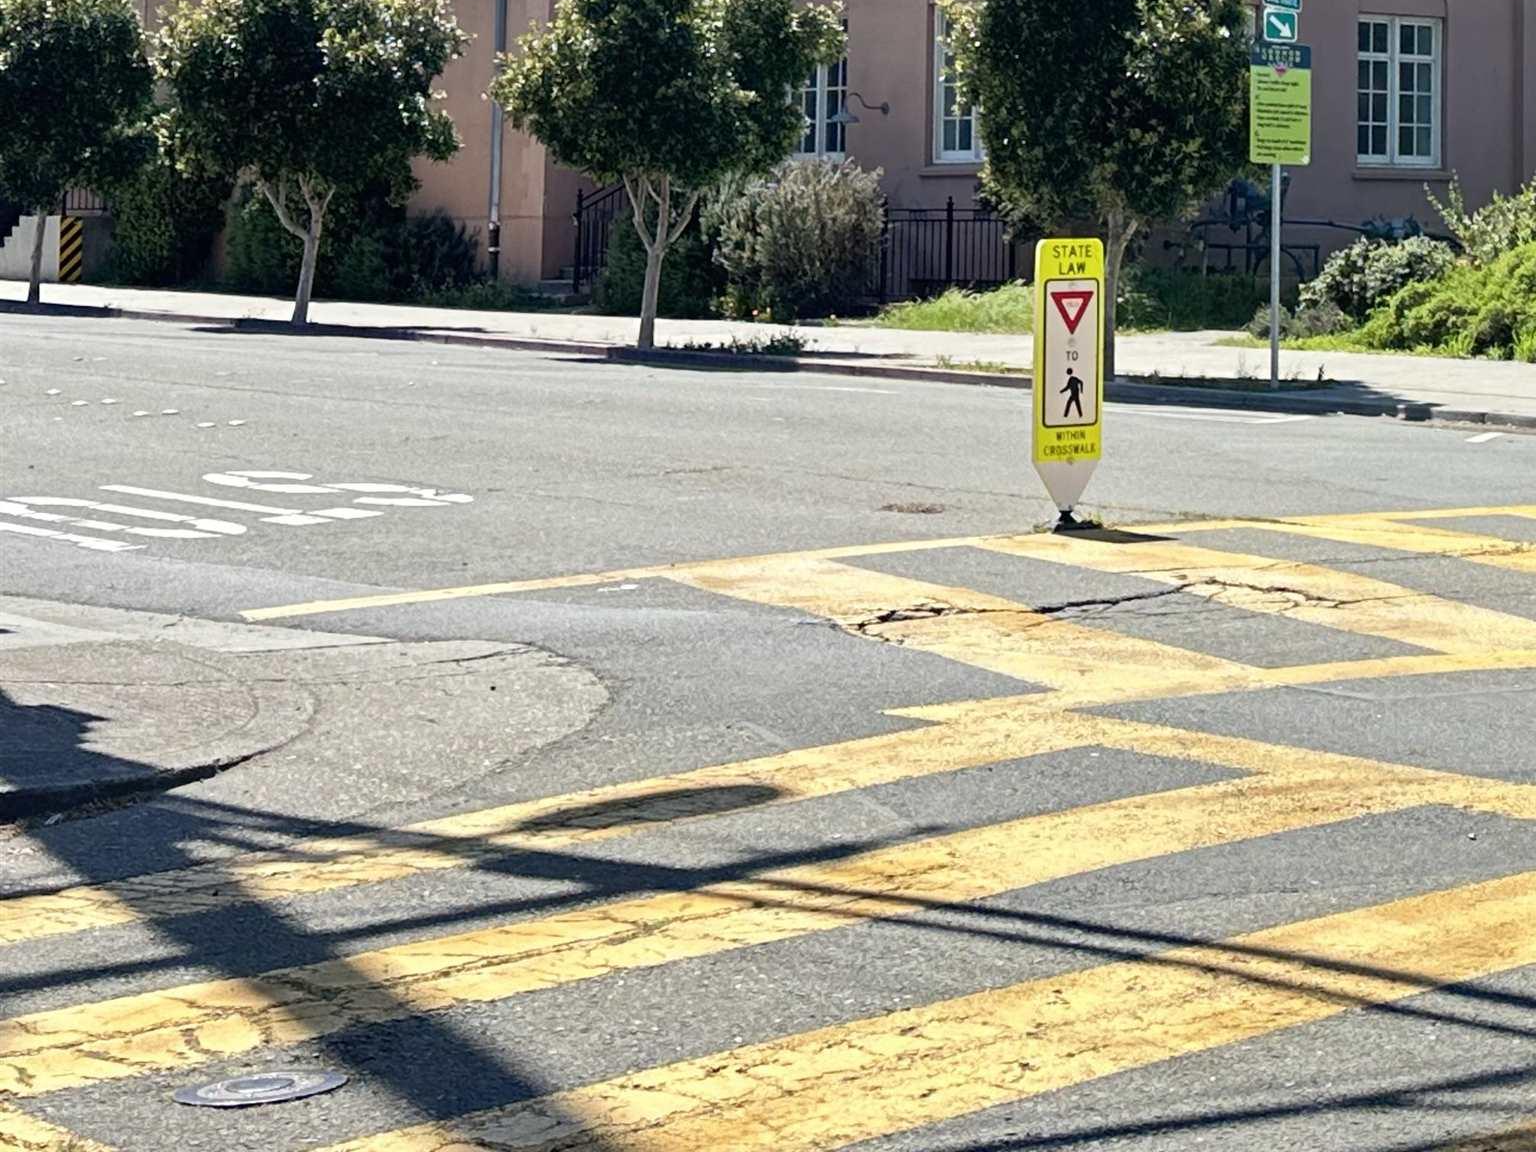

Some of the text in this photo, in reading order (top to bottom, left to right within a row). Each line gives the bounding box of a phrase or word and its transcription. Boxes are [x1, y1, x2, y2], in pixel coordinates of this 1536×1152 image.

[1052, 244, 1093, 259] STATE
[1058, 262, 1086, 275] LAW
[1066, 350, 1079, 361] TO
[1056, 430, 1086, 441] WITHIN
[1043, 442, 1097, 456] CROSSWALK
